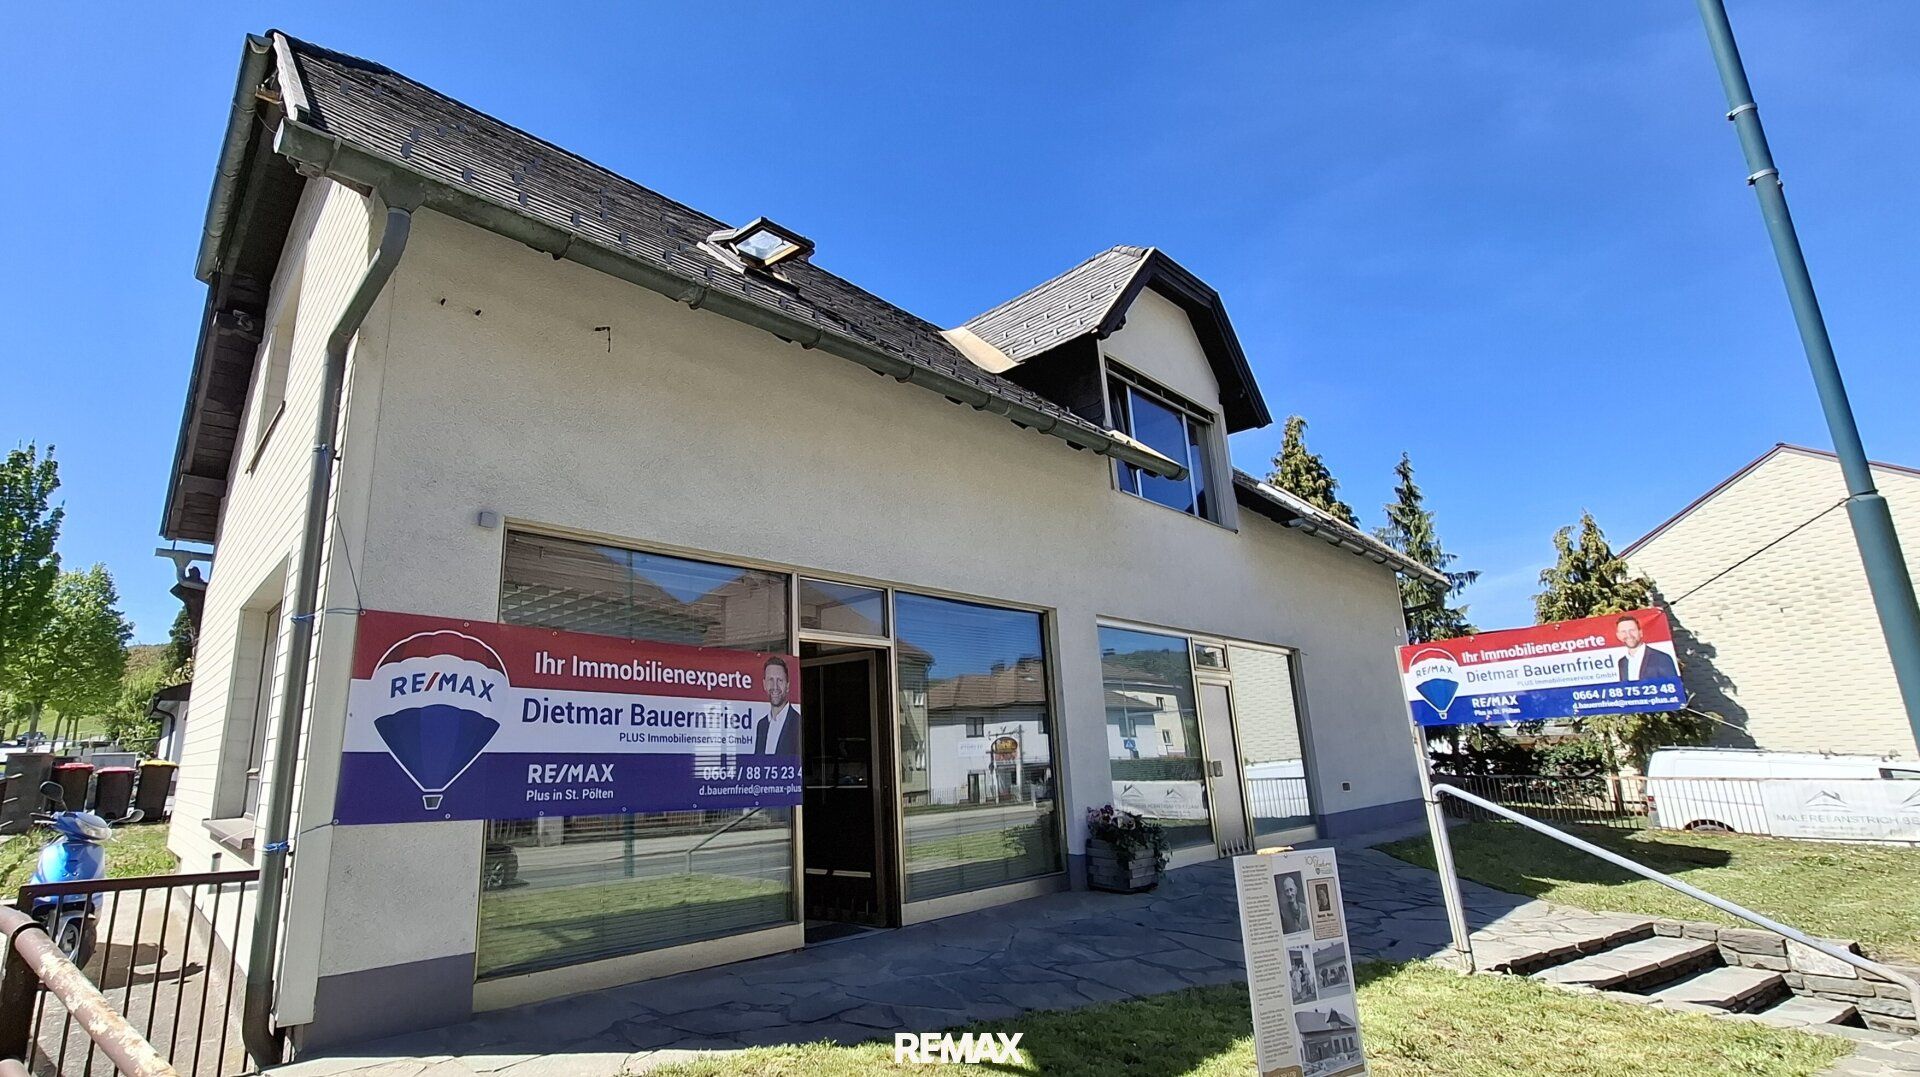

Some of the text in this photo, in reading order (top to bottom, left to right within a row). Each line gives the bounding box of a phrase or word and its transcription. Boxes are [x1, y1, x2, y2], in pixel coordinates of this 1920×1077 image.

[1461, 635, 1605, 663] Ihr Immobilienexperte
[535, 651, 752, 691] Ihr Immobilienexperte
[1415, 664, 1453, 678] RE/MAX
[1466, 654, 1614, 683] Dietmar Bauernfried
[1596, 671, 1617, 680] GmbH
[390, 672, 495, 702] RE/MAX
[1572, 690, 1599, 700] 0664
[1608, 687, 1623, 698] 88
[1625, 686, 1640, 696] 75
[1641, 684, 1658, 695] 23
[1660, 683, 1676, 693] 48
[1472, 695, 1518, 708] RE/MAX
[522, 697, 752, 730] Dietmar Bauernfried
[619, 732, 753, 745] PLUS Immobilienservice GmbH
[527, 763, 615, 784] RE/MAX
[703, 766, 735, 780] 0664
[737, 767, 743, 781] /
[746, 766, 761, 780] 88
[763, 766, 778, 780] 75
[781, 766, 795, 780] 23
[526, 787, 614, 801] Plus in St. Pölten
